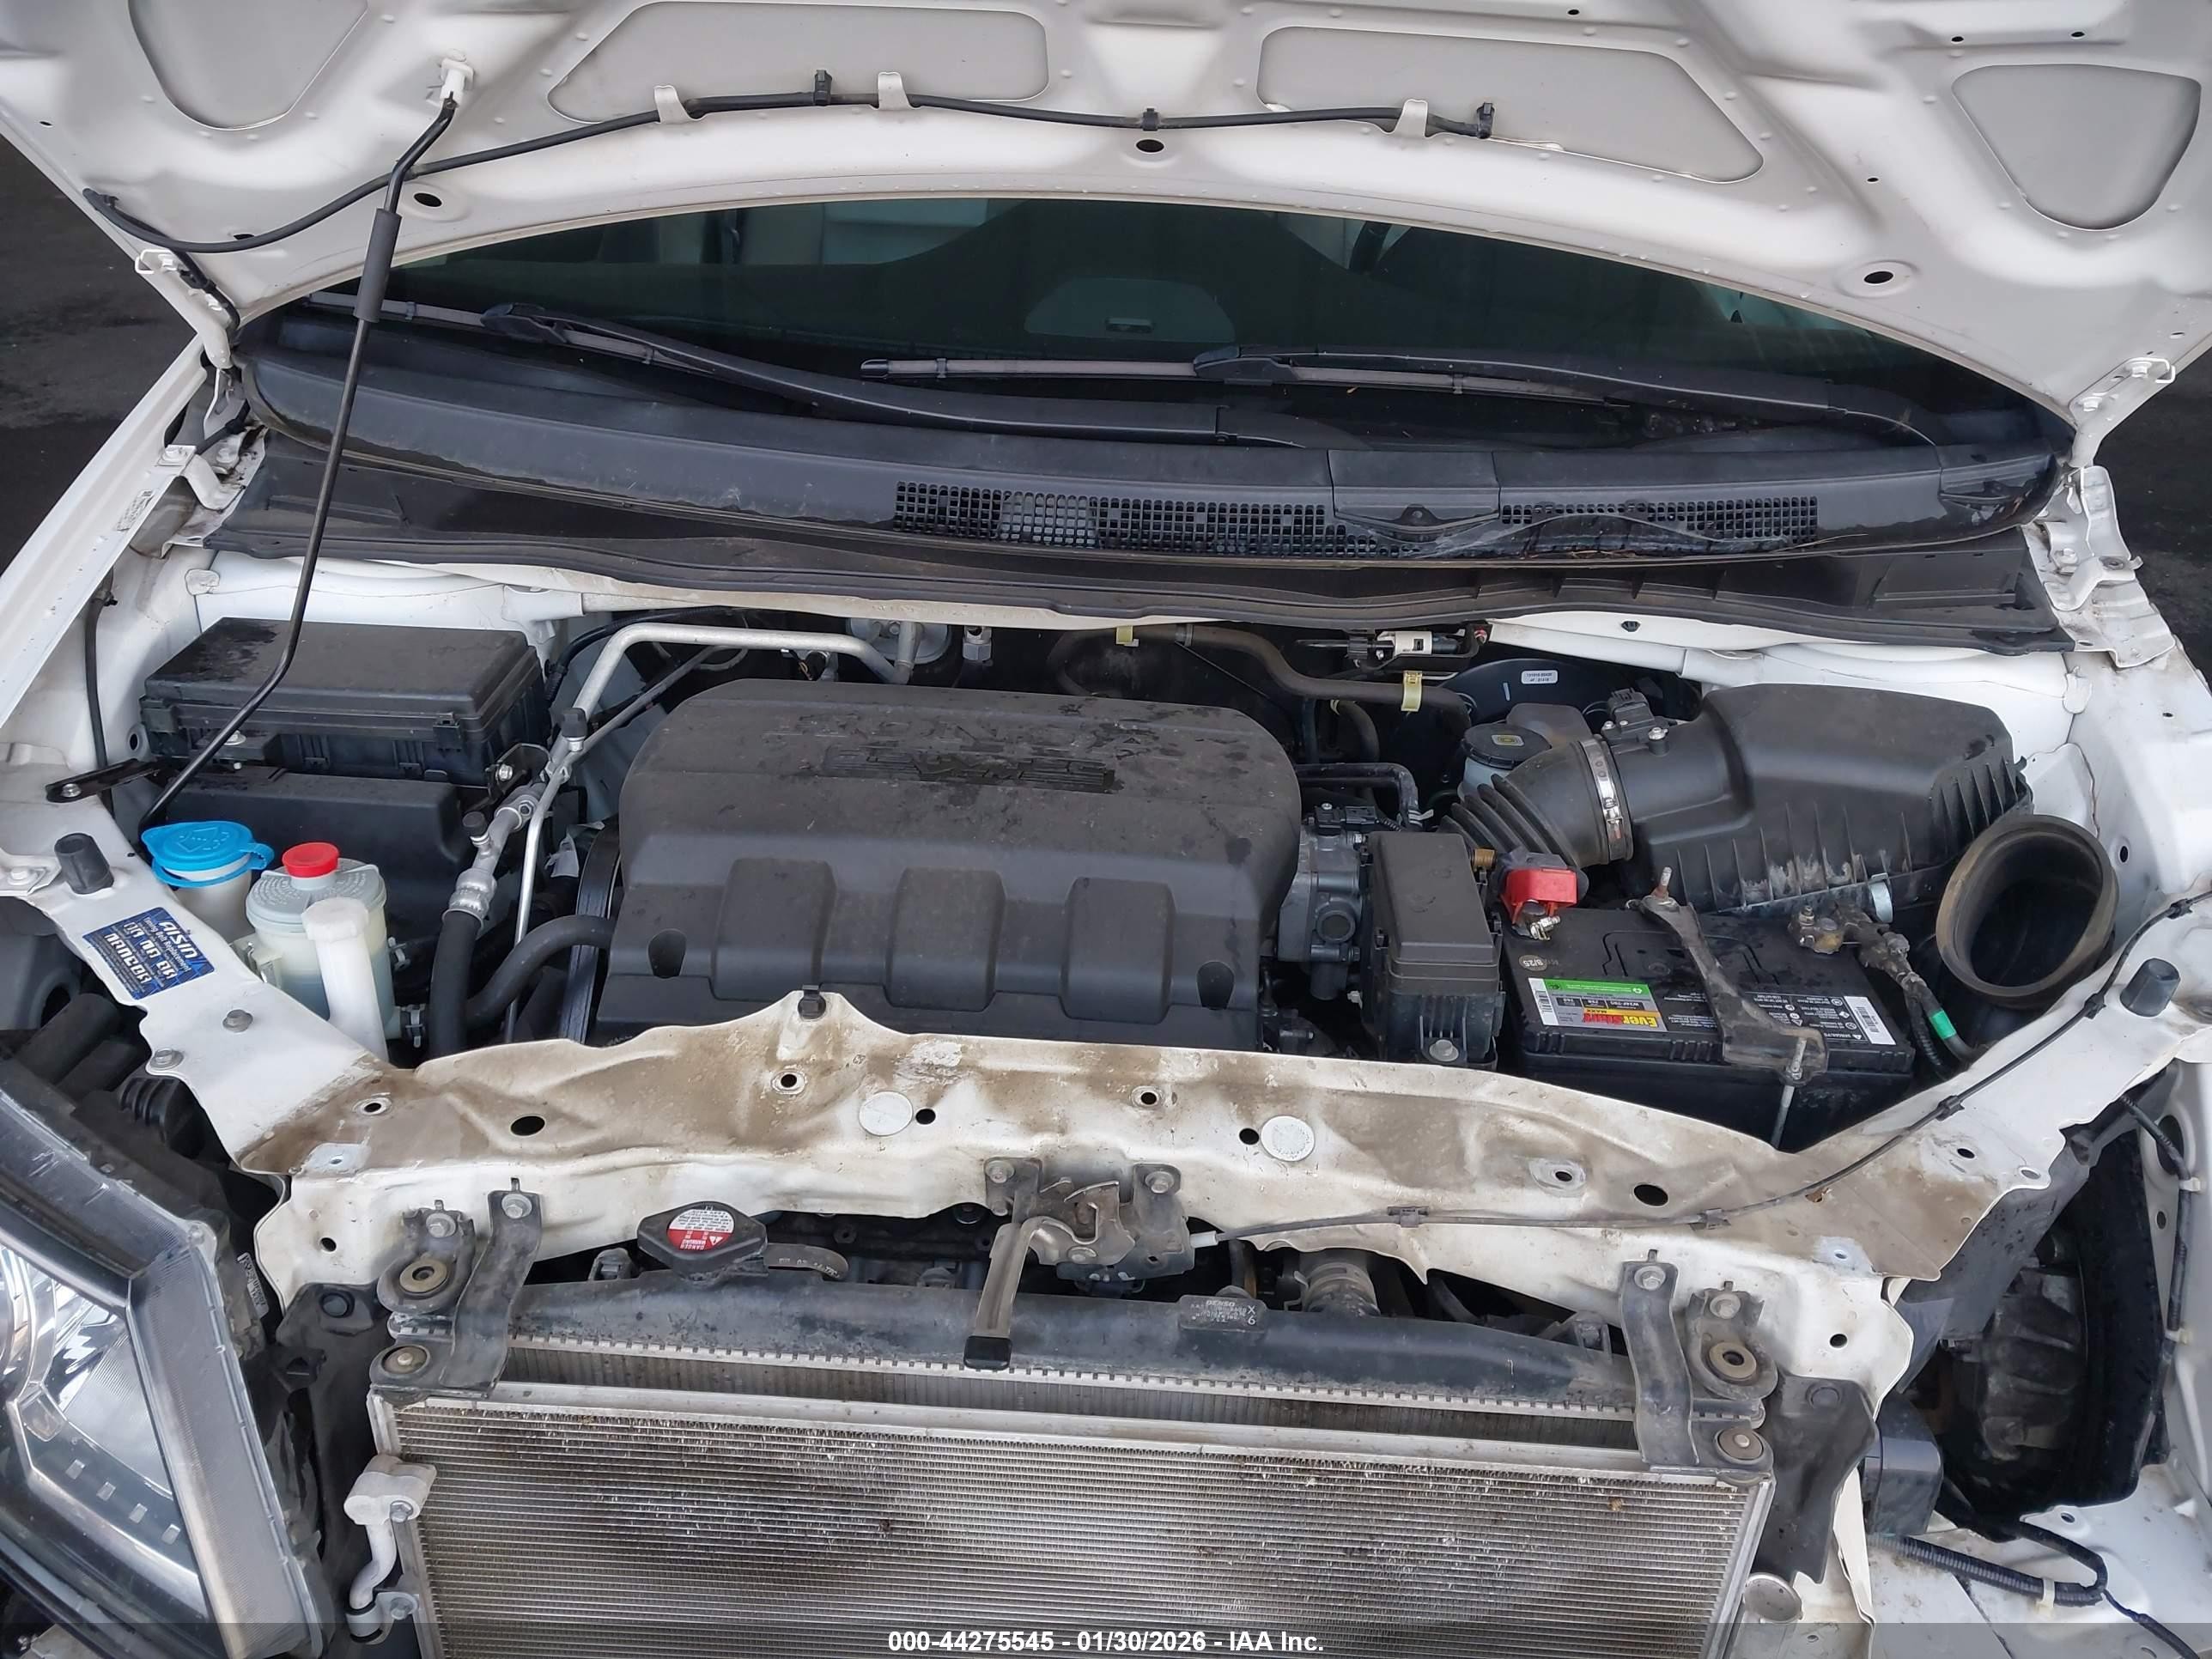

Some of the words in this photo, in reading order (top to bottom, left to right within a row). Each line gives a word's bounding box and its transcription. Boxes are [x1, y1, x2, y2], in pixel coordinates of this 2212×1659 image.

[143, 916, 160, 932] Timing
[155, 930, 167, 942] Belt
[162, 940, 191, 972] Replacement
[158, 922, 198, 958] AISIN
[1583, 1013, 1658, 1027] EverStart
